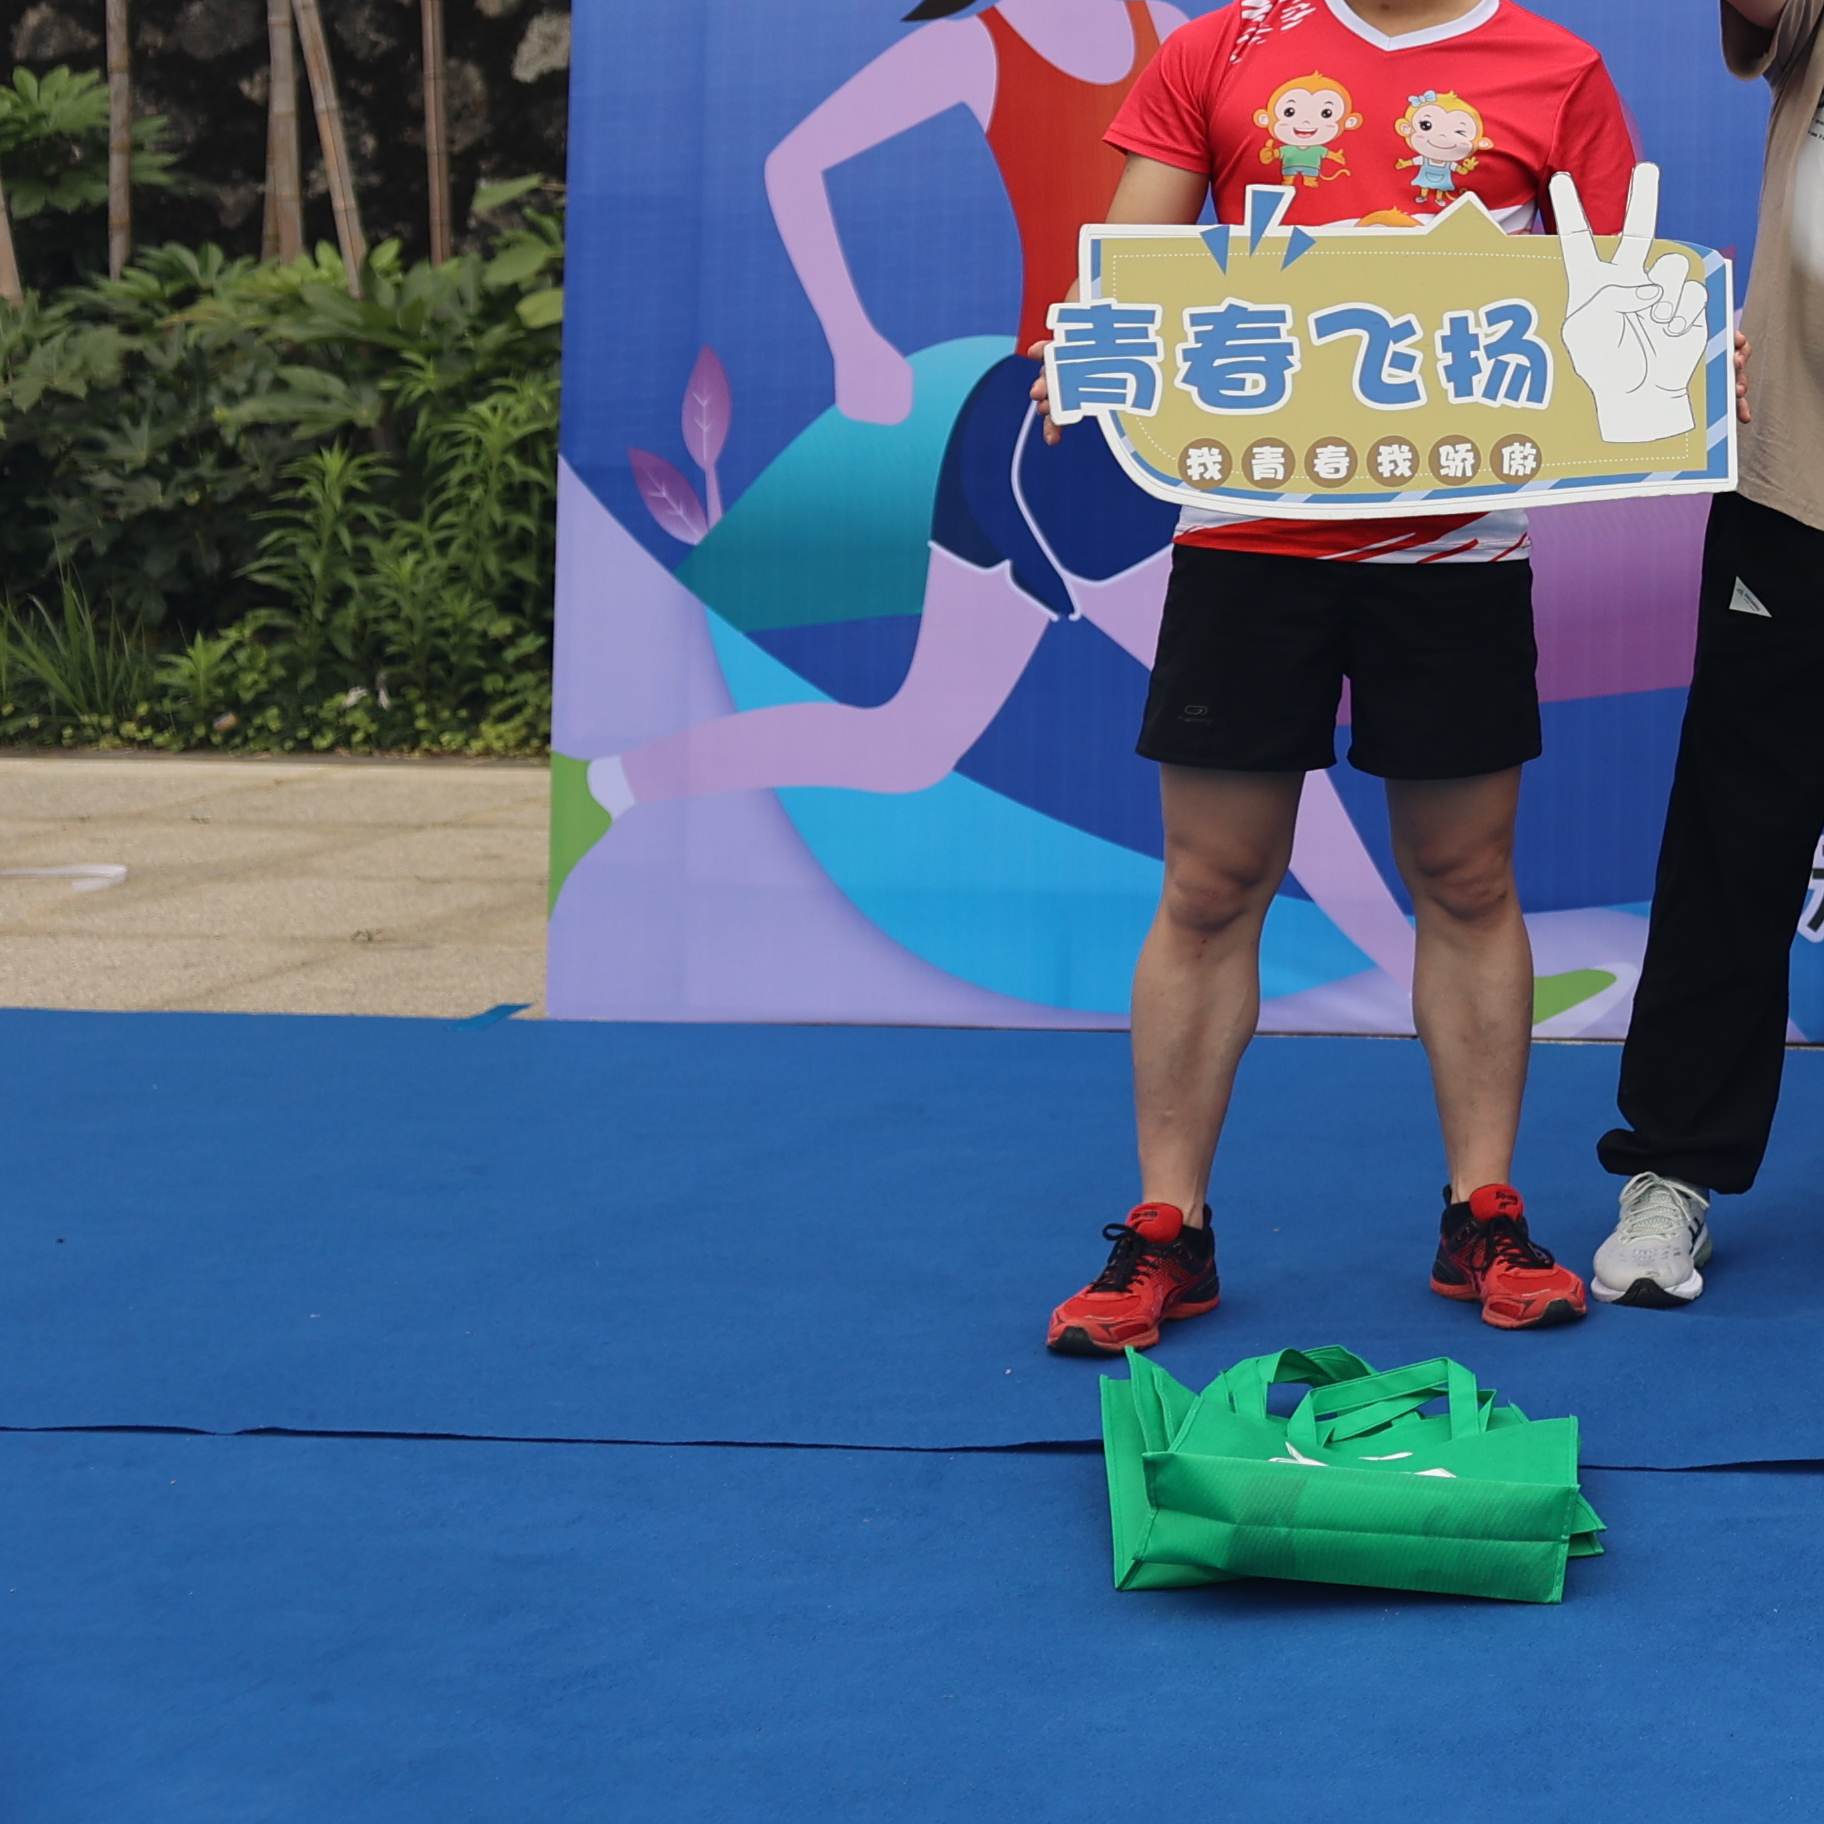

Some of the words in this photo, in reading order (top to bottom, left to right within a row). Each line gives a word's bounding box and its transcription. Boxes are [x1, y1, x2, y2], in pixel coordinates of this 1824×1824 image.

[1046, 298, 1555, 423] 青春飞扬
[1185, 440, 1539, 483] 我青春我骄傲
